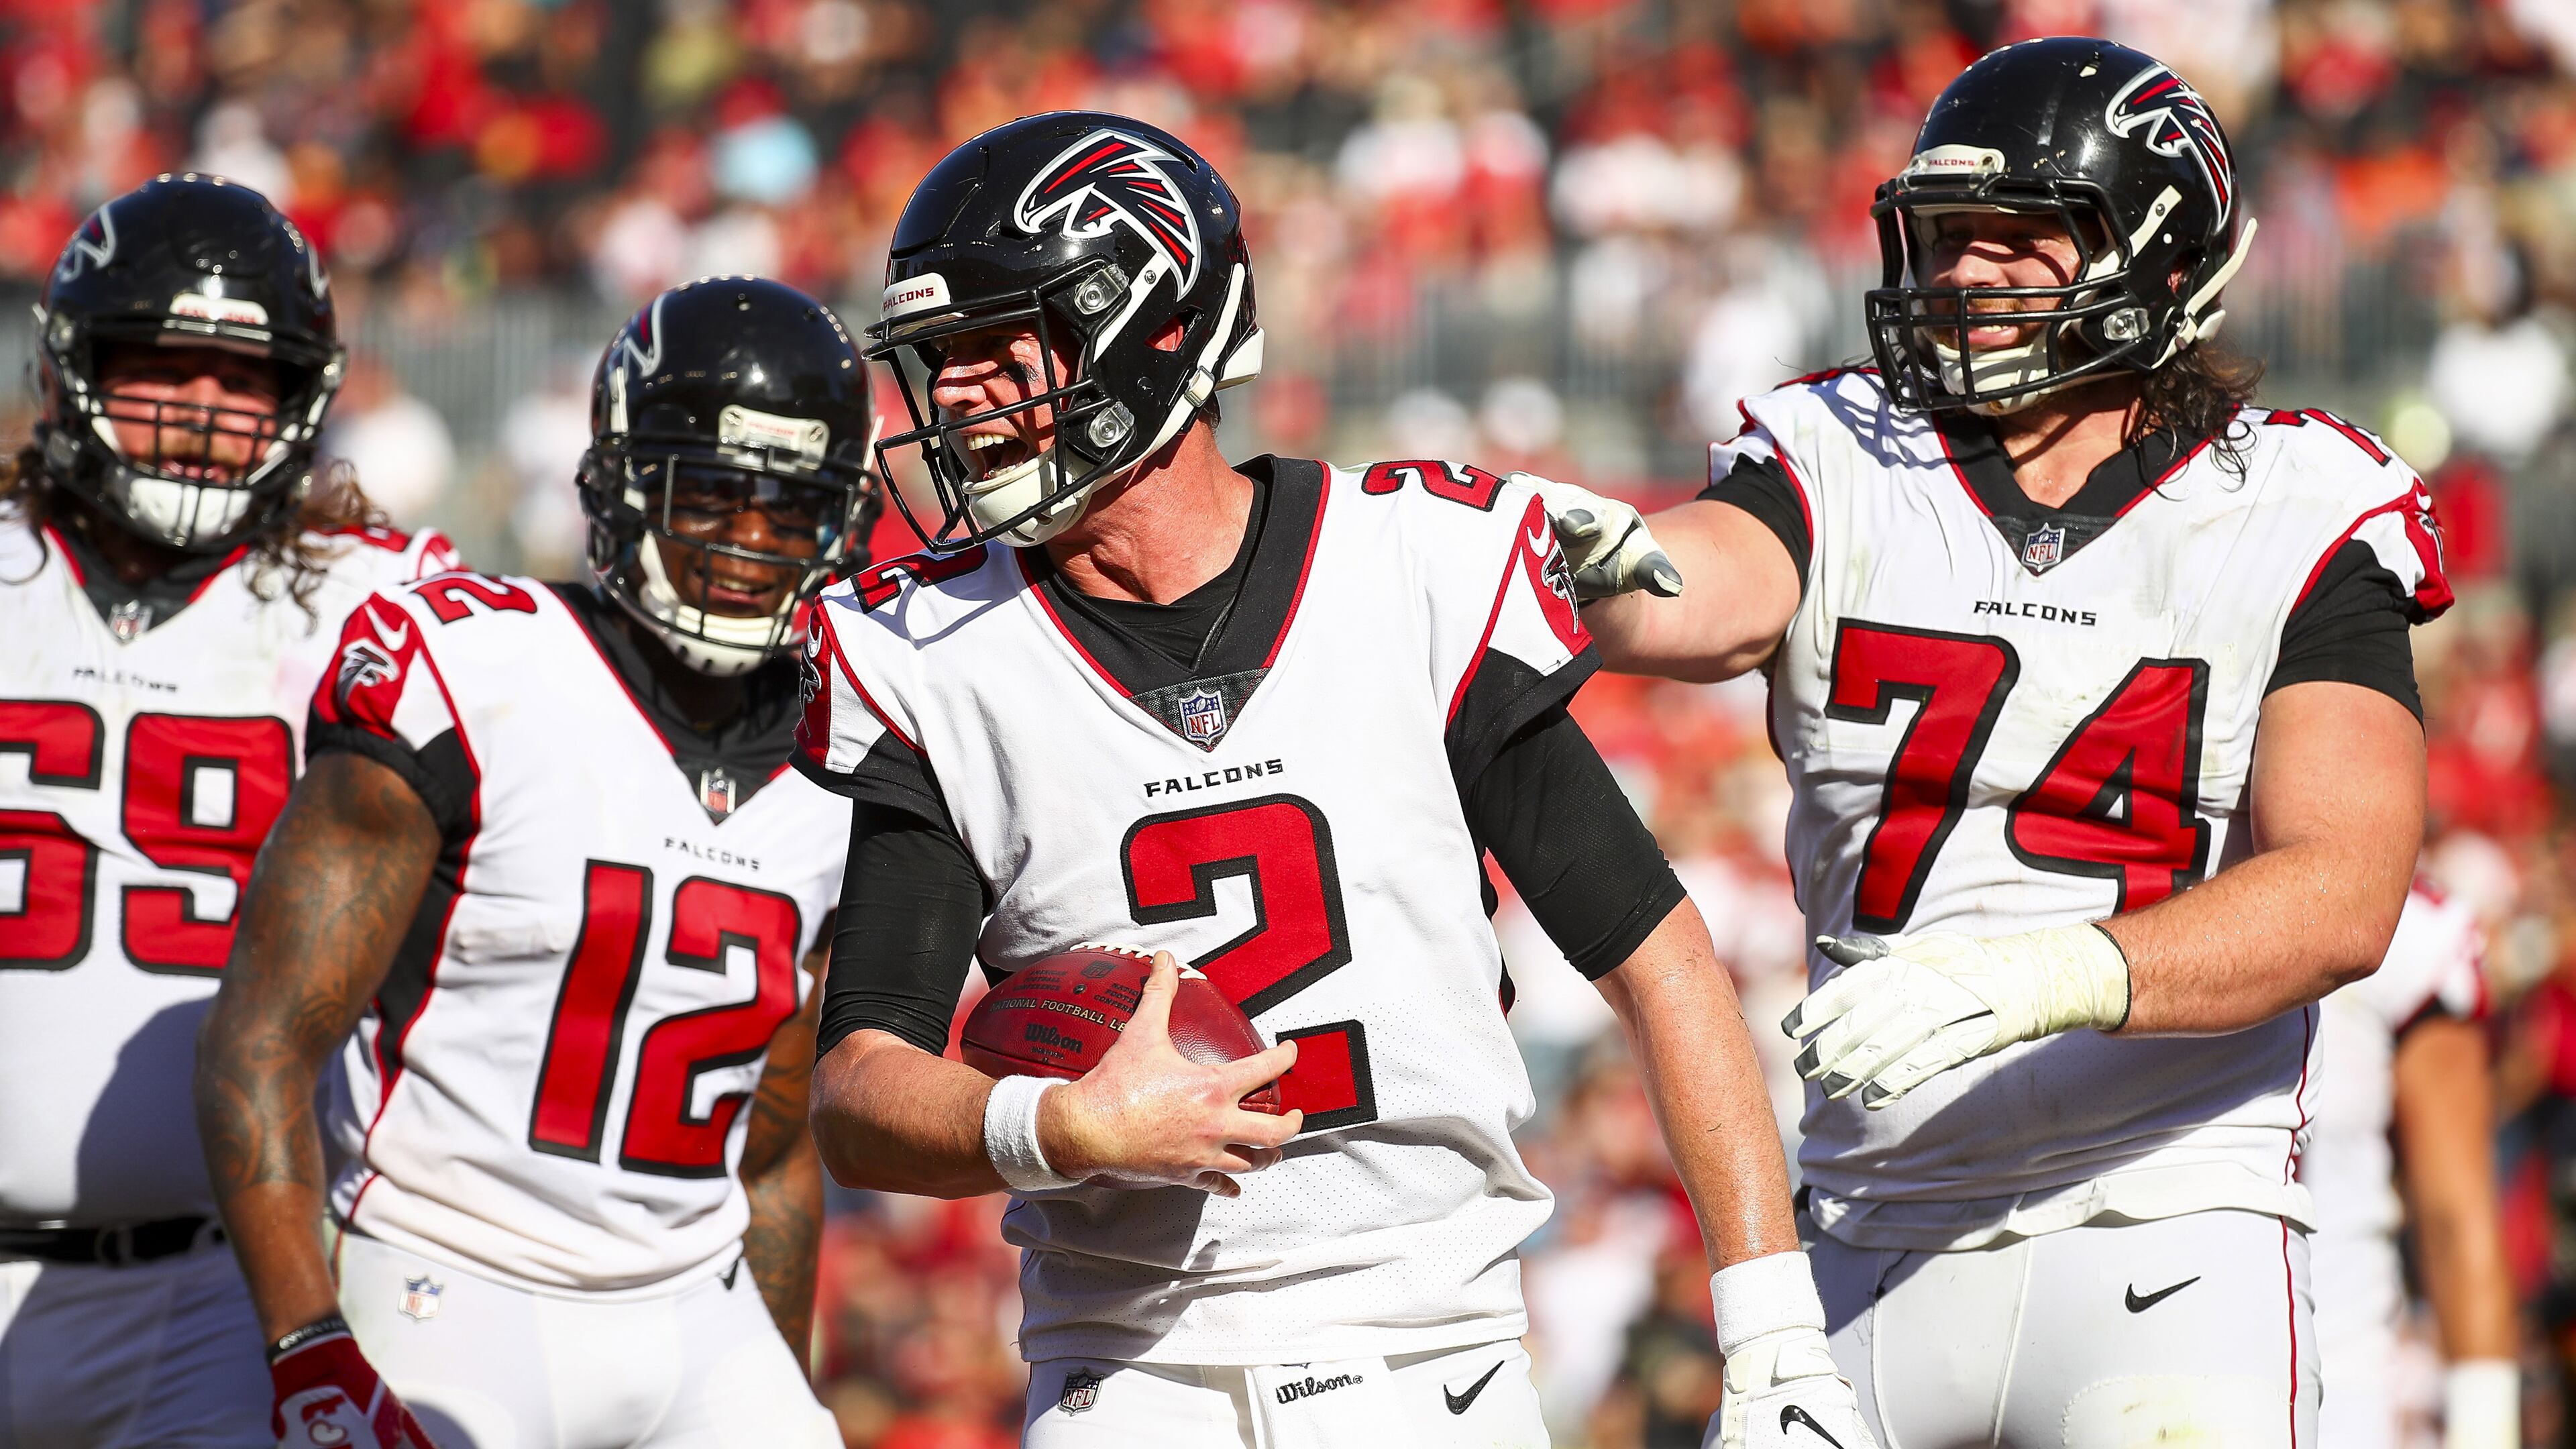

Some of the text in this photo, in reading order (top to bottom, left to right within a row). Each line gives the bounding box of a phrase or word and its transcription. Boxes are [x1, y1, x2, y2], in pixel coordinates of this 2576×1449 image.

[883, 287, 934, 312] FALCONS
[2027, 543, 2055, 564] NFL
[1974, 601, 2097, 626] FALCONS
[1188, 712, 1221, 735] NFL
[1143, 759, 1284, 798] FALCONS
[1824, 616, 2210, 934] 74
[0, 700, 296, 979] 69
[664, 837, 761, 871] FALCONS
[1120, 792, 1378, 1134] 2
[529, 858, 802, 1179] 12
[1040, 1000, 1106, 1025] FOOTBALL
[1109, 1018, 1126, 1032] LE
[1024, 1024, 1083, 1054] Wilson
[1063, 1389, 1091, 1407] NFL
